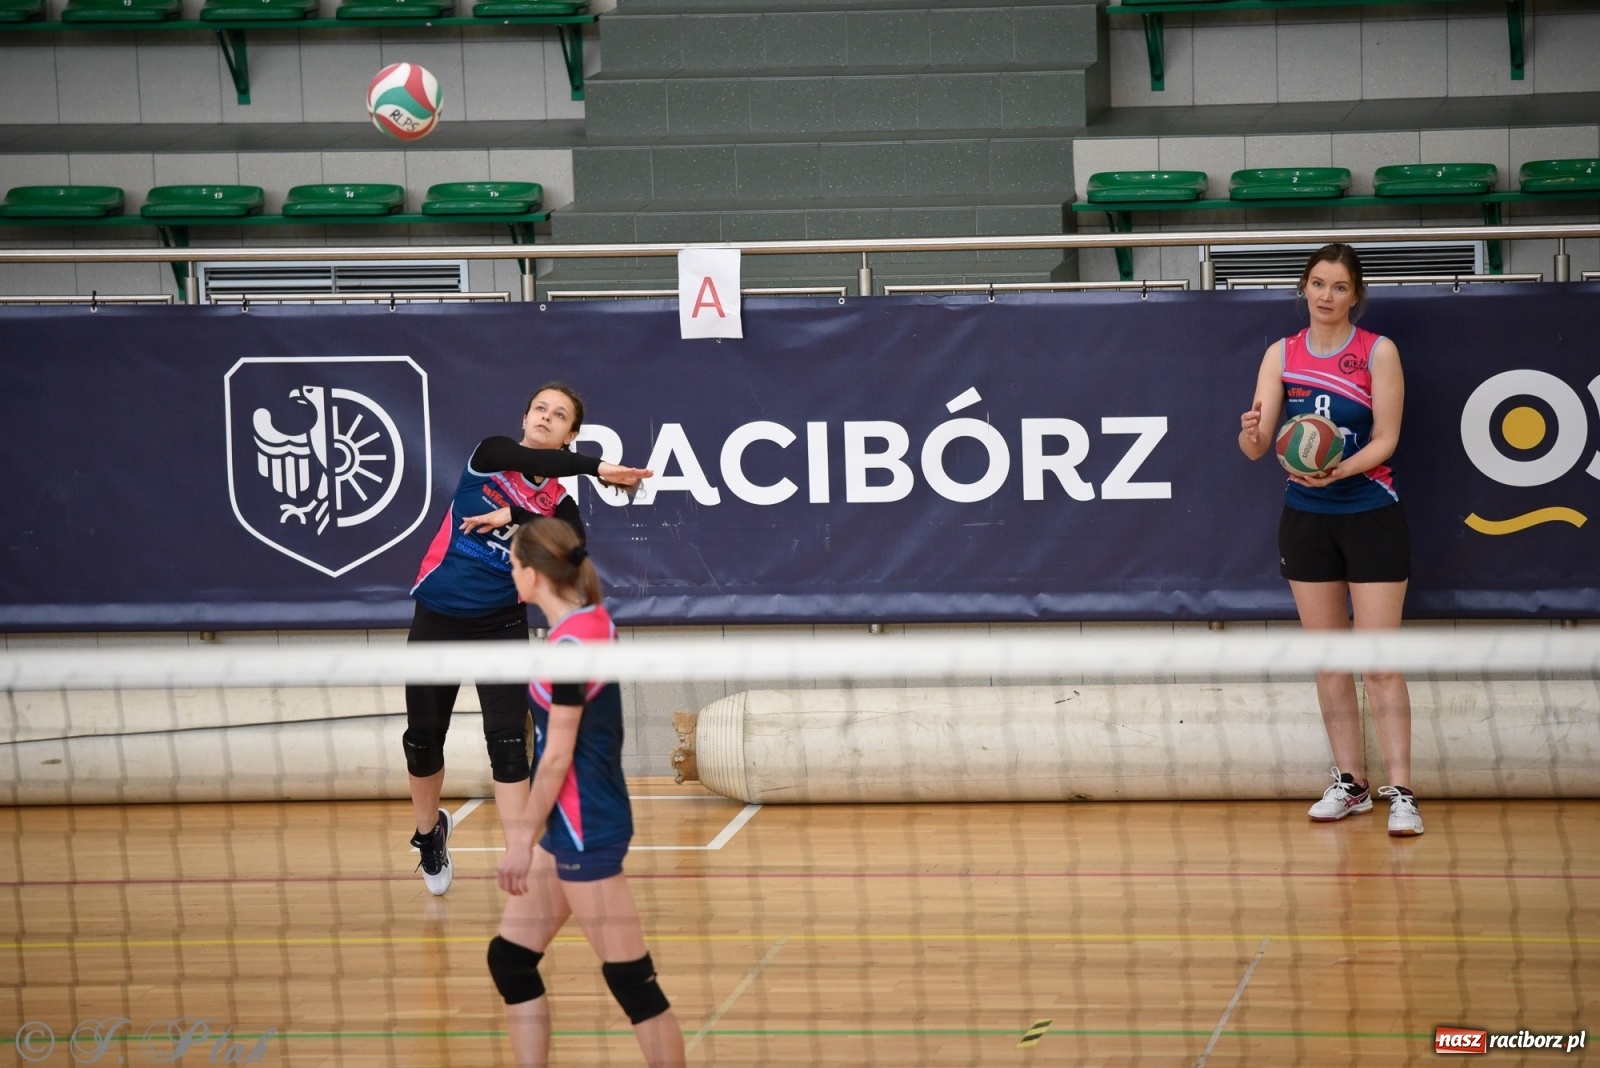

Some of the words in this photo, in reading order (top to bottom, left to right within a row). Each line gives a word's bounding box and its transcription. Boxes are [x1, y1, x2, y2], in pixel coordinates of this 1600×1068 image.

[389, 109, 420, 132] RLPS
[1436, 170, 1443, 178] 3
[214, 191, 223, 199] 13
[691, 276, 726, 318] A
[1314, 394, 1331, 420] 8
[1460, 369, 1600, 488] O
[560, 386, 1172, 506] RACIBÓRZ
[1301, 431, 1317, 459] molten
